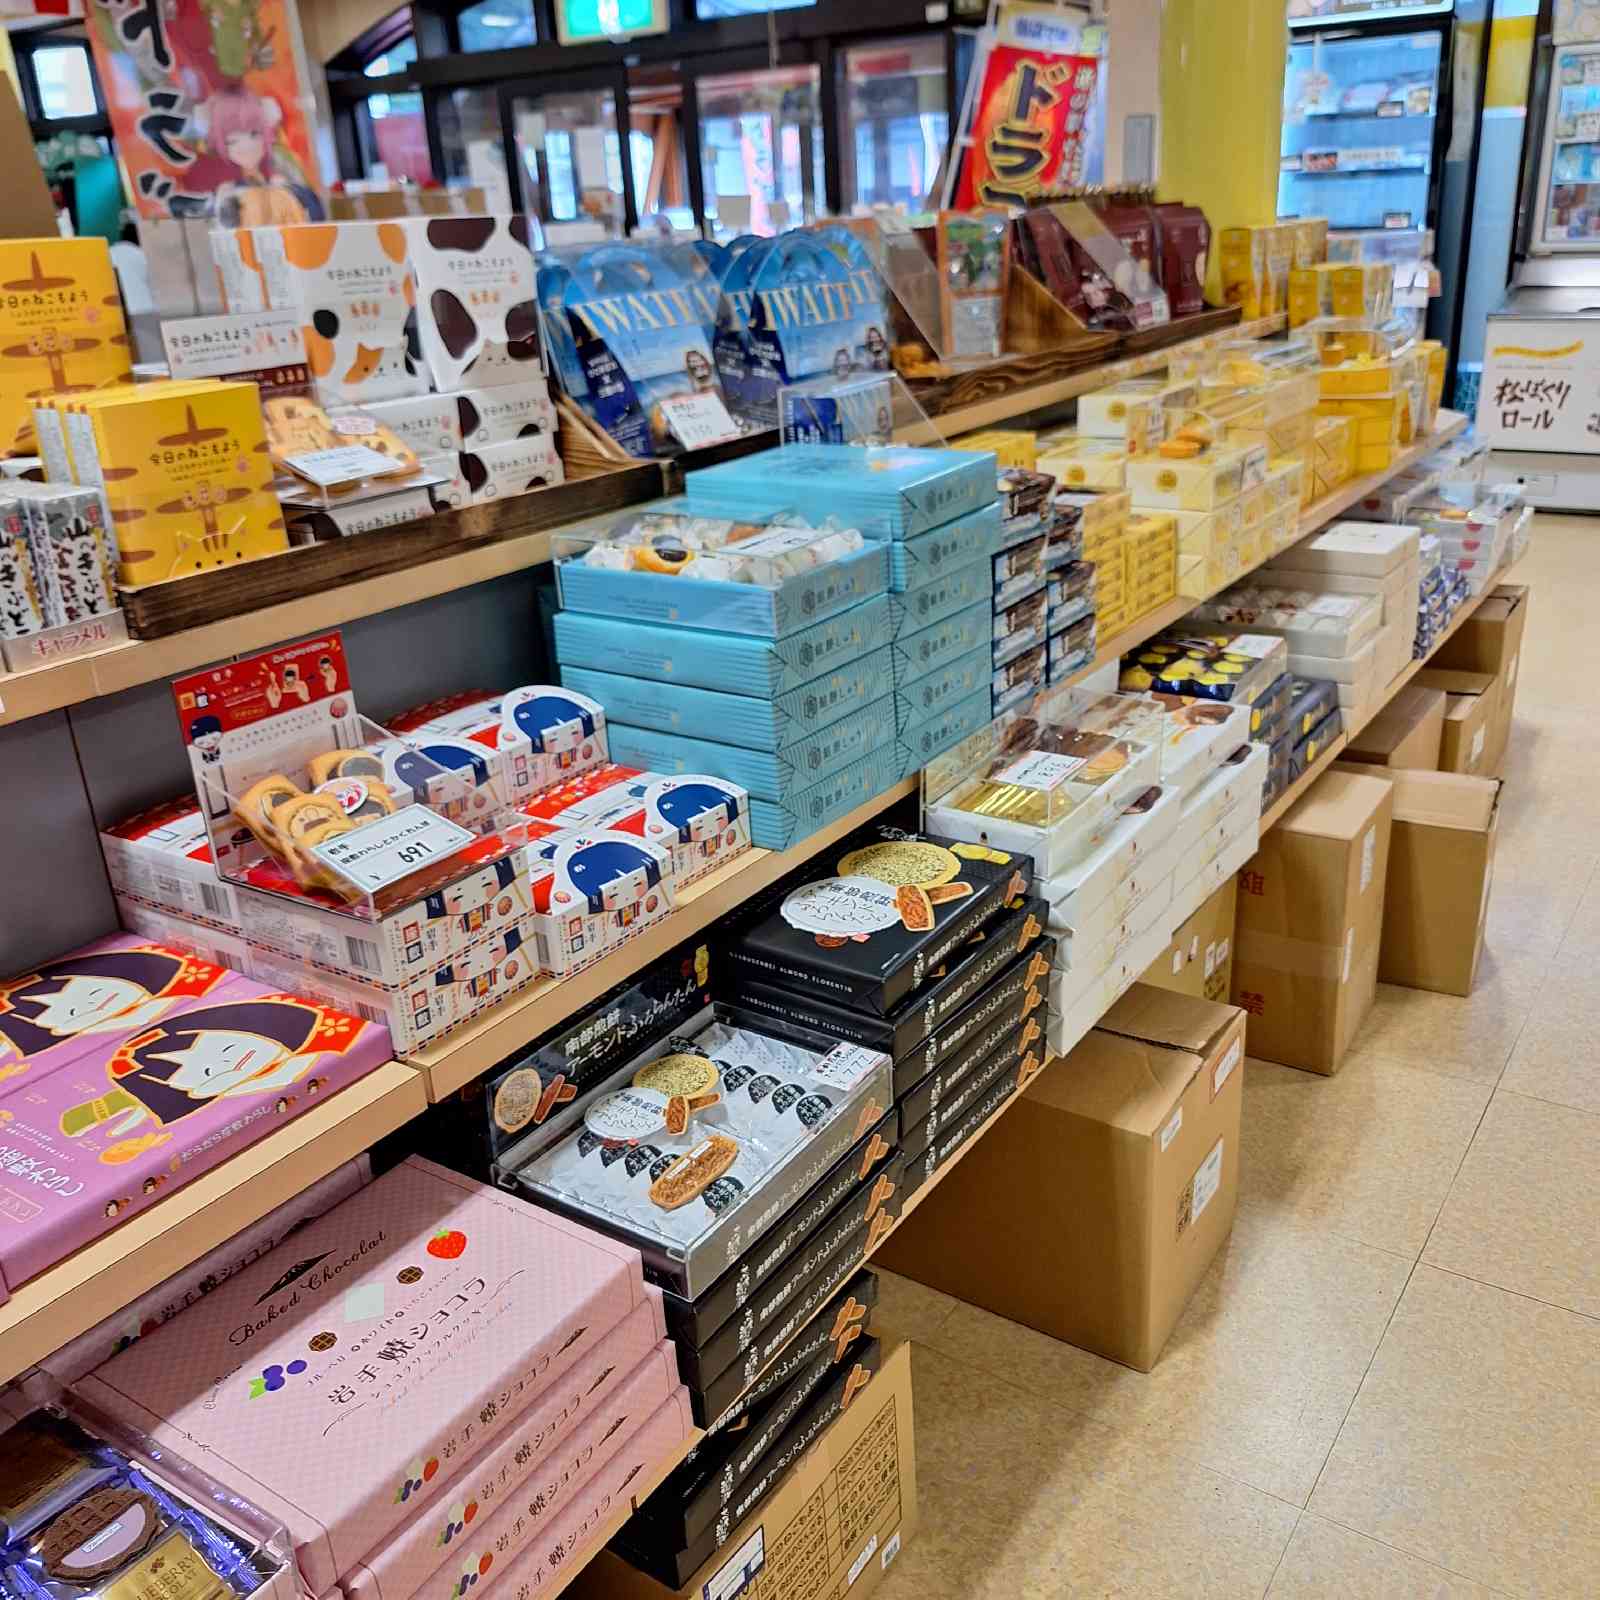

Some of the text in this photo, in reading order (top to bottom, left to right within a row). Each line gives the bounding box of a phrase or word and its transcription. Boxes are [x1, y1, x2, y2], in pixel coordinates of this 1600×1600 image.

[1502, 409, 1555, 430] ロール
[36, 623, 107, 656] キャラメル
[397, 841, 433, 864] 691
[228, 1291, 301, 1347] Baked
[300, 1230, 388, 1291] Chocolat
